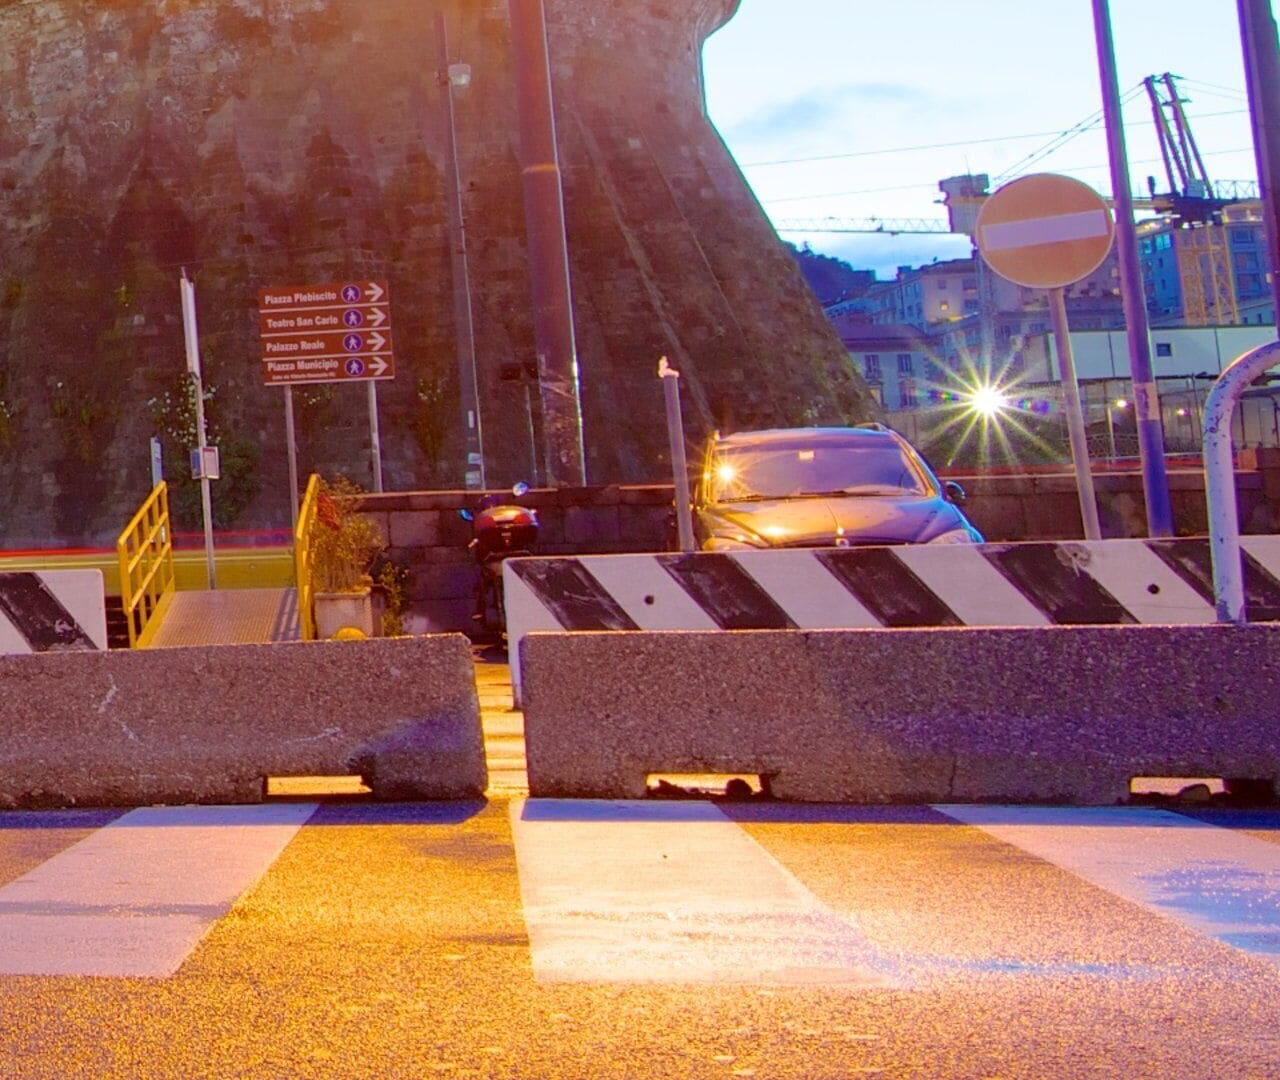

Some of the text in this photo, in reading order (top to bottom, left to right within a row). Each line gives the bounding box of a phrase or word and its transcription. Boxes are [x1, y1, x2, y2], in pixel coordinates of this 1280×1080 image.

[265, 292, 336, 304] Piazza Plebiscito
[267, 315, 338, 328] Teatro San Carlo
[266, 341, 325, 352] Palazzo Reale
[267, 360, 338, 371] Piazza Municipio
